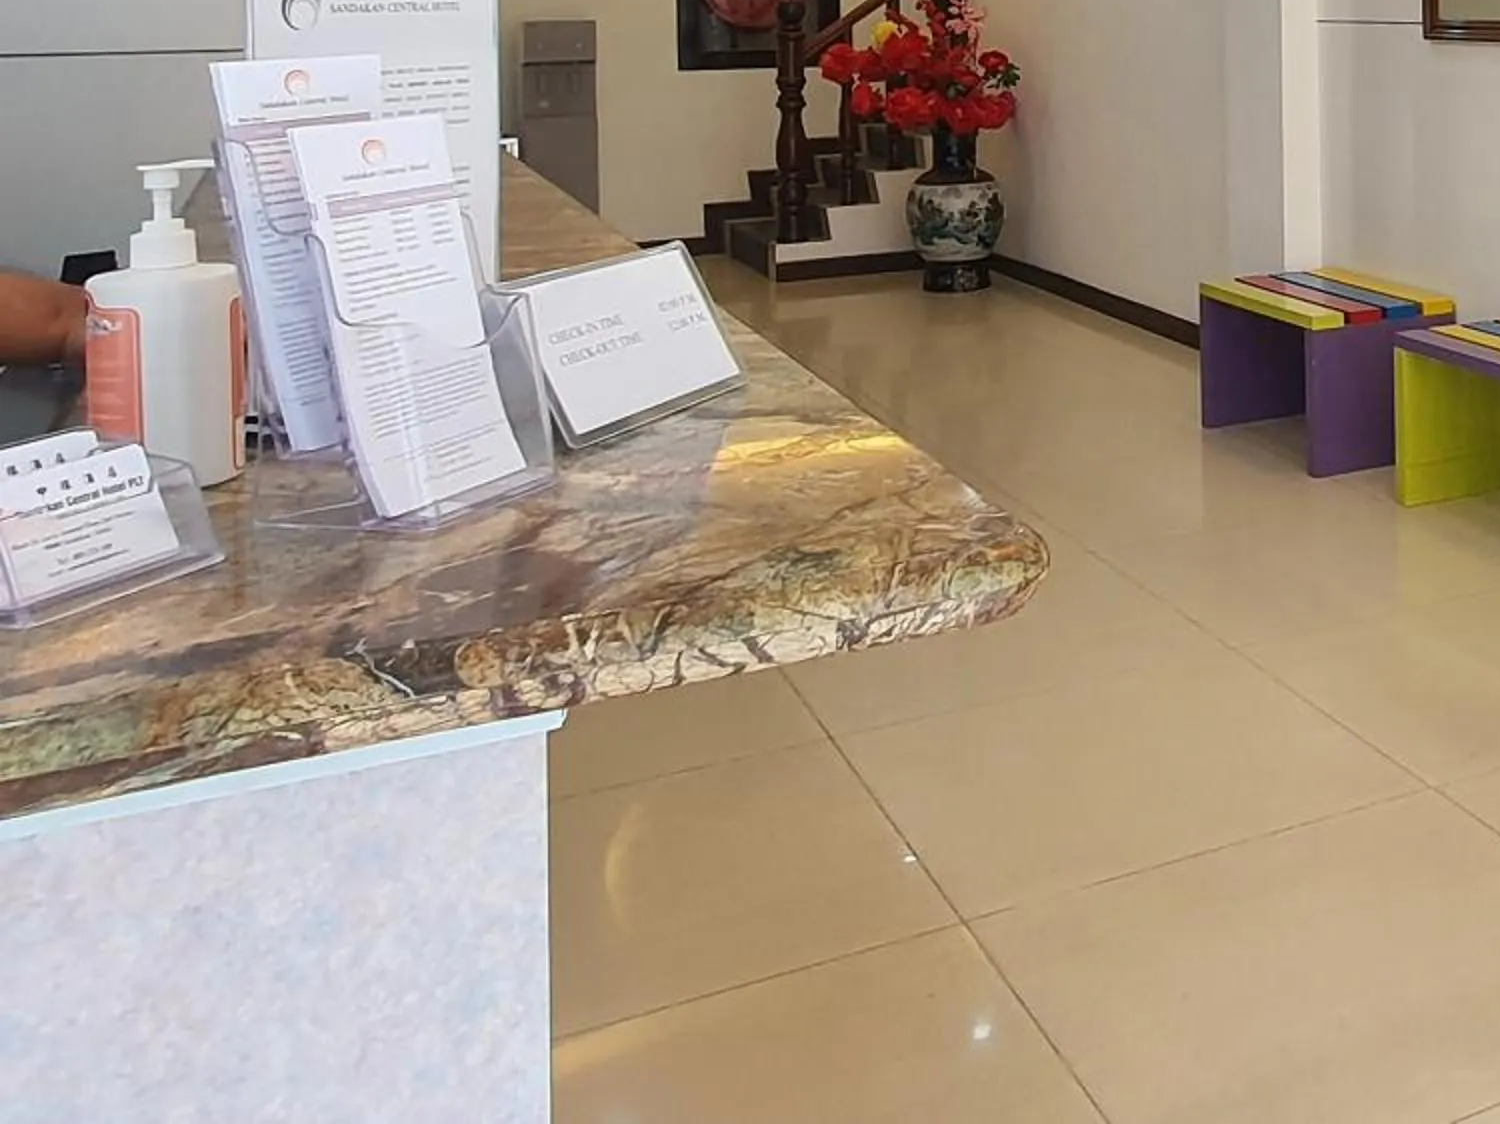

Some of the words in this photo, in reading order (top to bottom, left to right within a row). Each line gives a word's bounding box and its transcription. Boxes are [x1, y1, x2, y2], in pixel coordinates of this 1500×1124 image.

[329, 2, 385, 14] SANDAKAN
[387, 0, 431, 13] CENTRAL
[65, 487, 100, 507] Central
